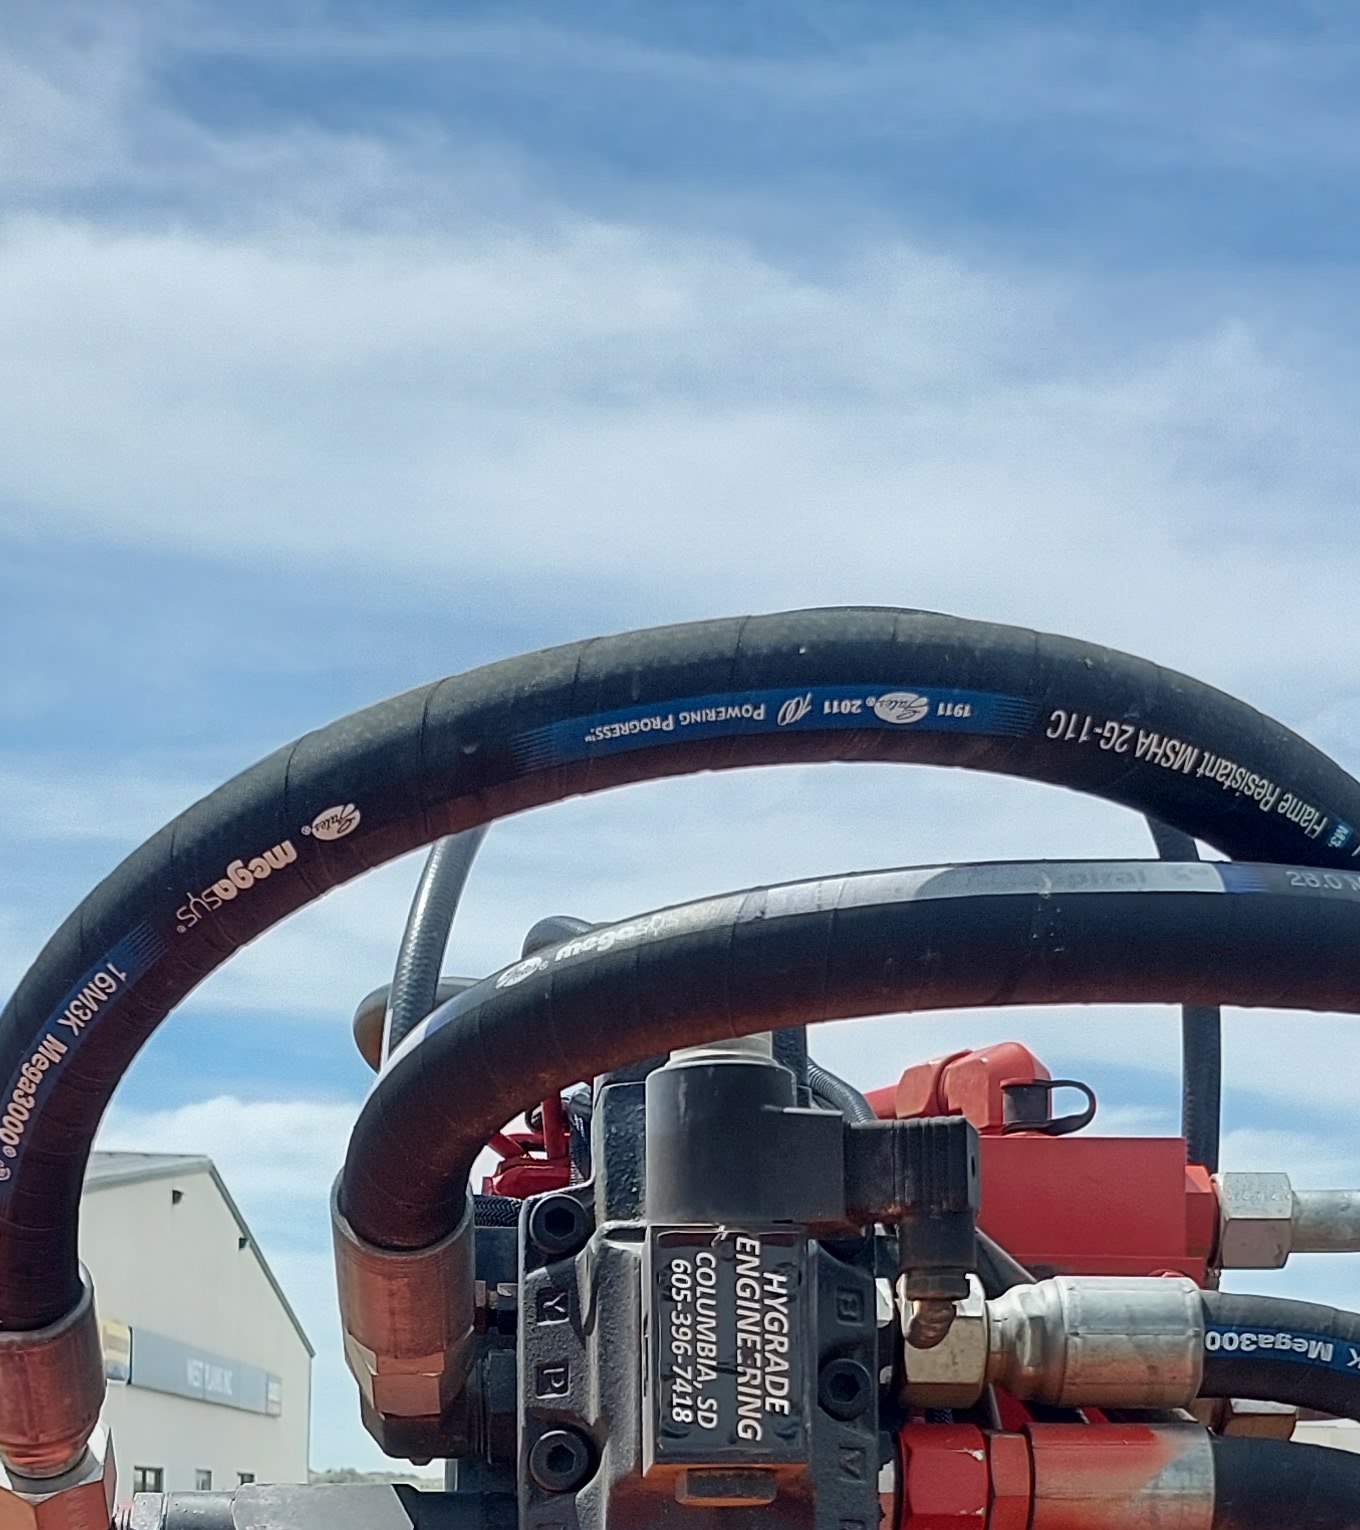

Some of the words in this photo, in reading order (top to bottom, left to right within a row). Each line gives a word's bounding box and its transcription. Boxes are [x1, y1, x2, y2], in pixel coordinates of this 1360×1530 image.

[1136, 729, 1198, 774] MSHA
[1195, 751, 1285, 812] Resistant
[1277, 791, 1328, 839] Flame
[56, 963, 128, 1036] 16M3K
[671, 1258, 694, 1424] 605-396-7418
[695, 1252, 718, 1389] COLUMBIA,
[735, 1236, 763, 1441] ENGINEERING
[763, 1272, 790, 1416] HYGRADE
[697, 1396, 719, 1430] SD
